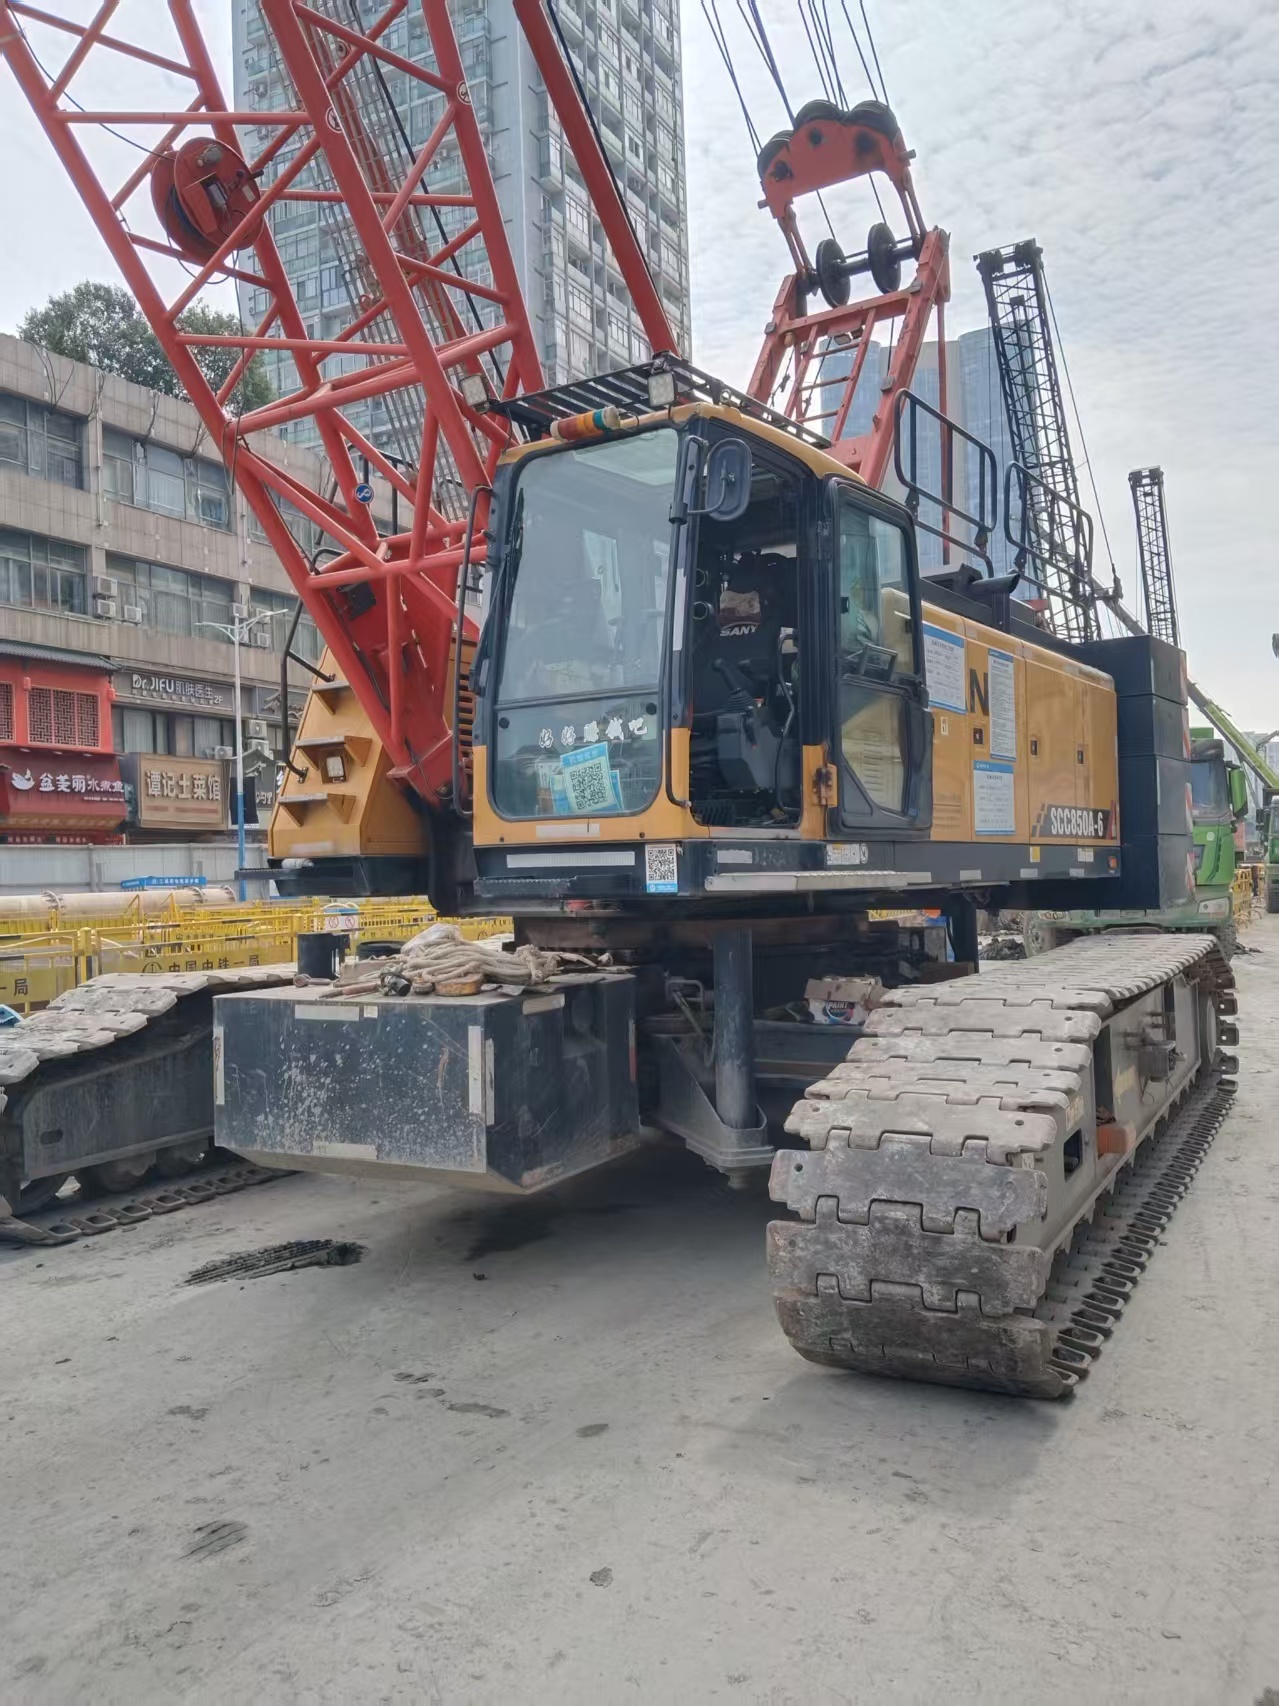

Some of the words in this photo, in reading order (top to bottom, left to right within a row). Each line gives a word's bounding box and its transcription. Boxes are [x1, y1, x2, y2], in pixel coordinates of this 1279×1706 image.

[720, 625, 757, 637] SANY
[146, 770, 220, 800] 谭记土菜馆
[1051, 807, 1104, 837] SCC850A-6
